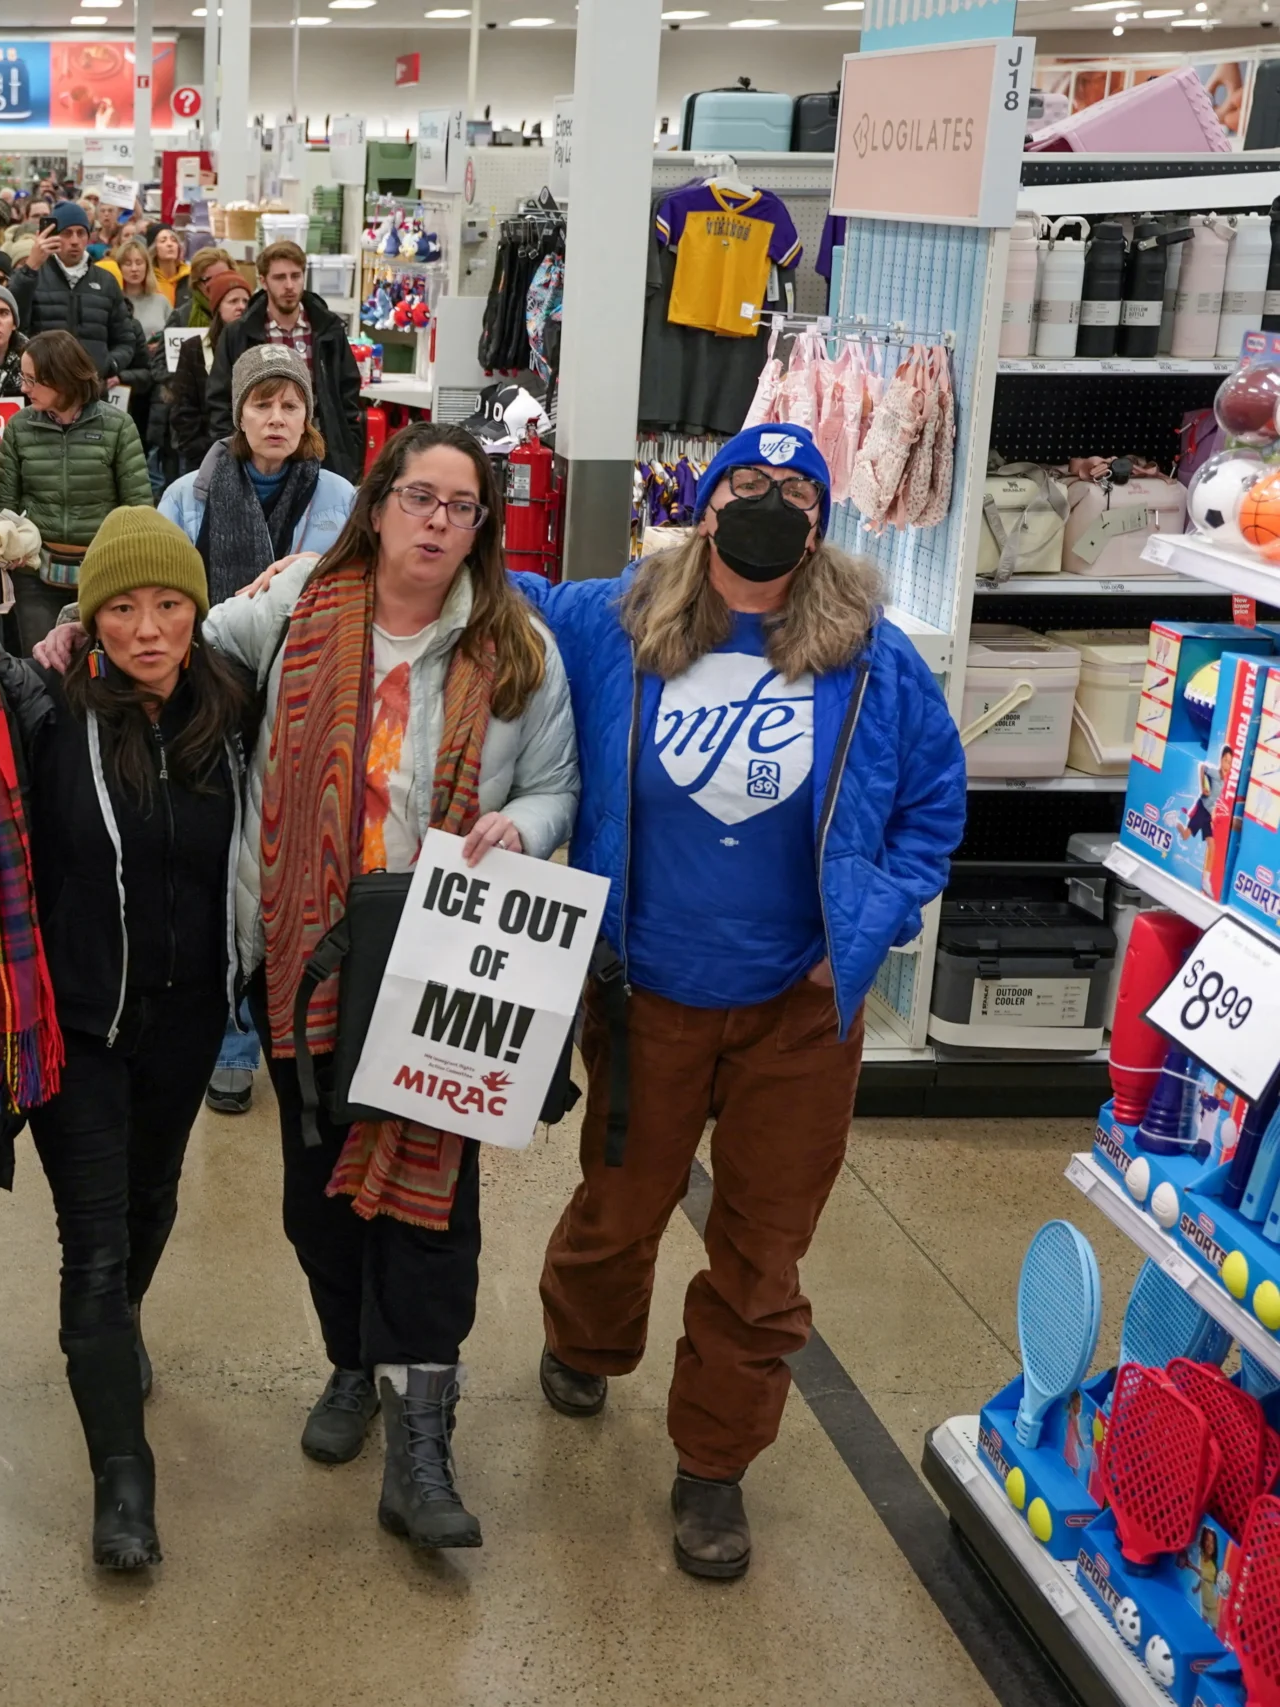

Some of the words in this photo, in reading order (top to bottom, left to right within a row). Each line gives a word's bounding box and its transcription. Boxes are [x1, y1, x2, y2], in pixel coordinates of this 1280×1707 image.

[760, 434, 804, 458] mfe
[1241, 661, 1258, 713] FLAG
[655, 668, 815, 796] mfe
[1224, 712, 1251, 800] FOOTBALL
[754, 779, 773, 793] 59
[1125, 810, 1172, 850] SPORTS
[422, 867, 490, 925] ICE
[498, 889, 587, 949] OUT
[469, 944, 509, 981] OF
[995, 997, 1025, 1006] COOLER
[996, 988, 1033, 997] OUTDOOR
[412, 980, 535, 1064] MN!
[428, 1062, 445, 1071] Action
[446, 1067, 473, 1079] Committee
[459, 1064, 475, 1072] Rights
[393, 1065, 508, 1117] MIRAC
[1179, 1214, 1227, 1268] SPORTS
